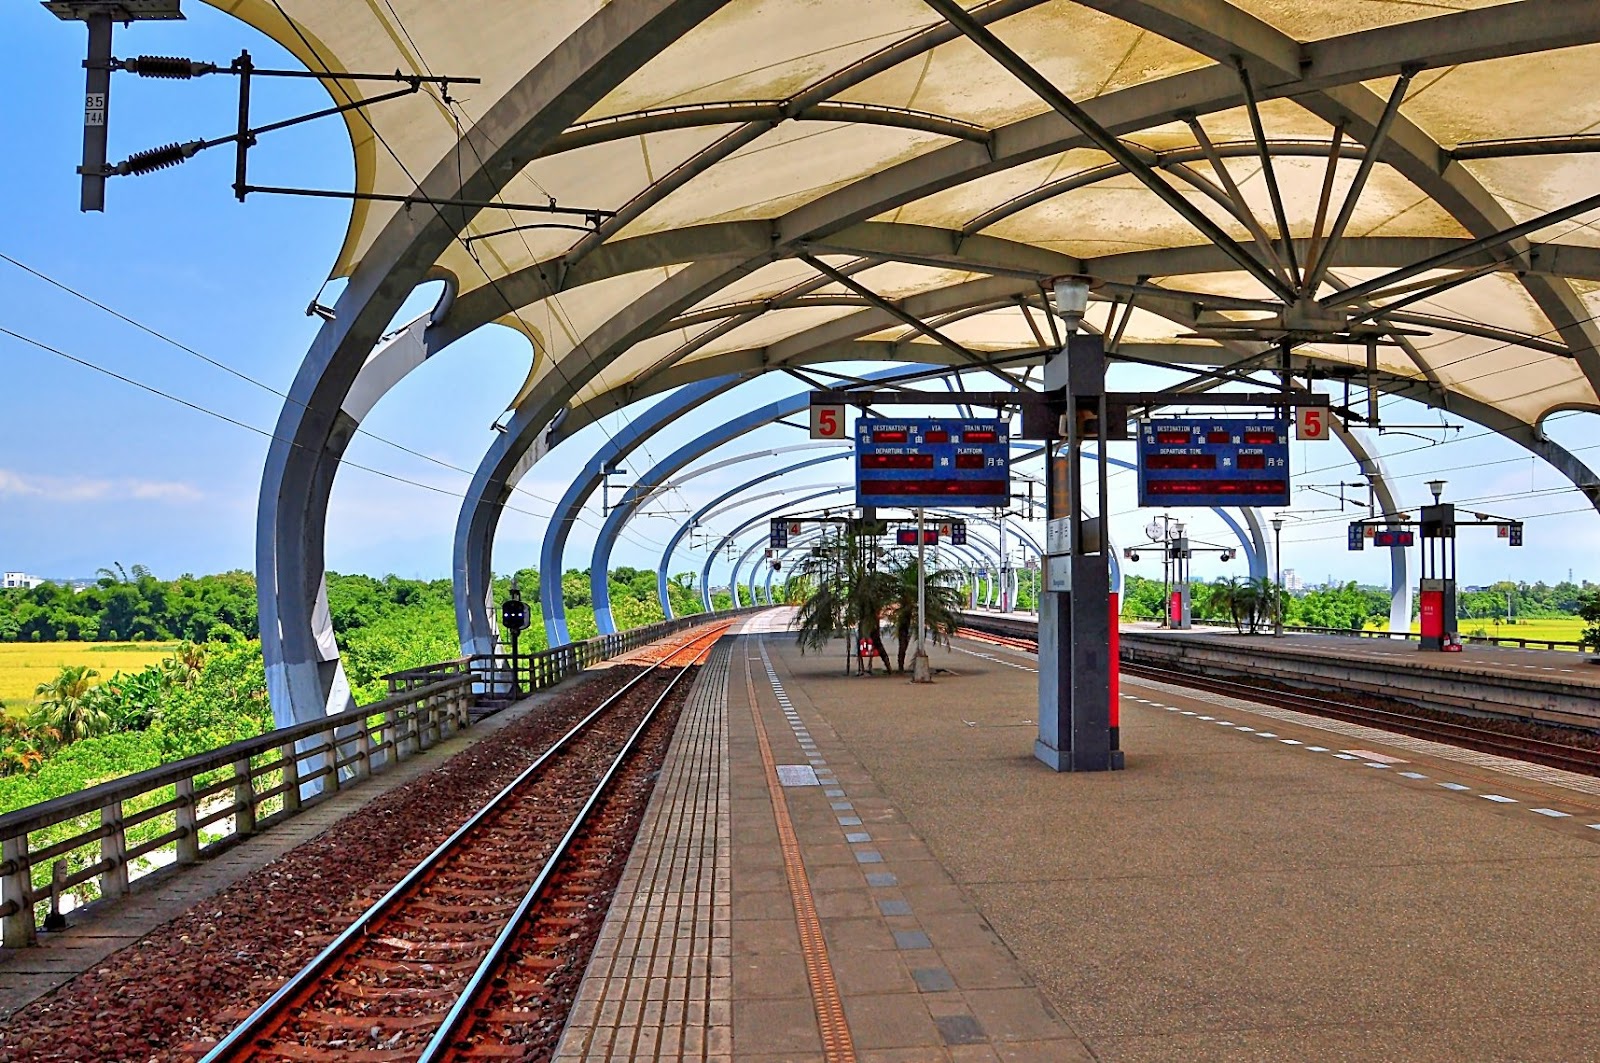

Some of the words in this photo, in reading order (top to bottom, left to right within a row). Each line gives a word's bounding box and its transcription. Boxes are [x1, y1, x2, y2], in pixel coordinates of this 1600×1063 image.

[86, 97, 103, 107] 85
[85, 113, 103, 123] T4A
[819, 410, 837, 436] 5
[1304, 411, 1321, 437] 5
[988, 457, 1004, 466] 月台
[1268, 457, 1284, 466] 月台
